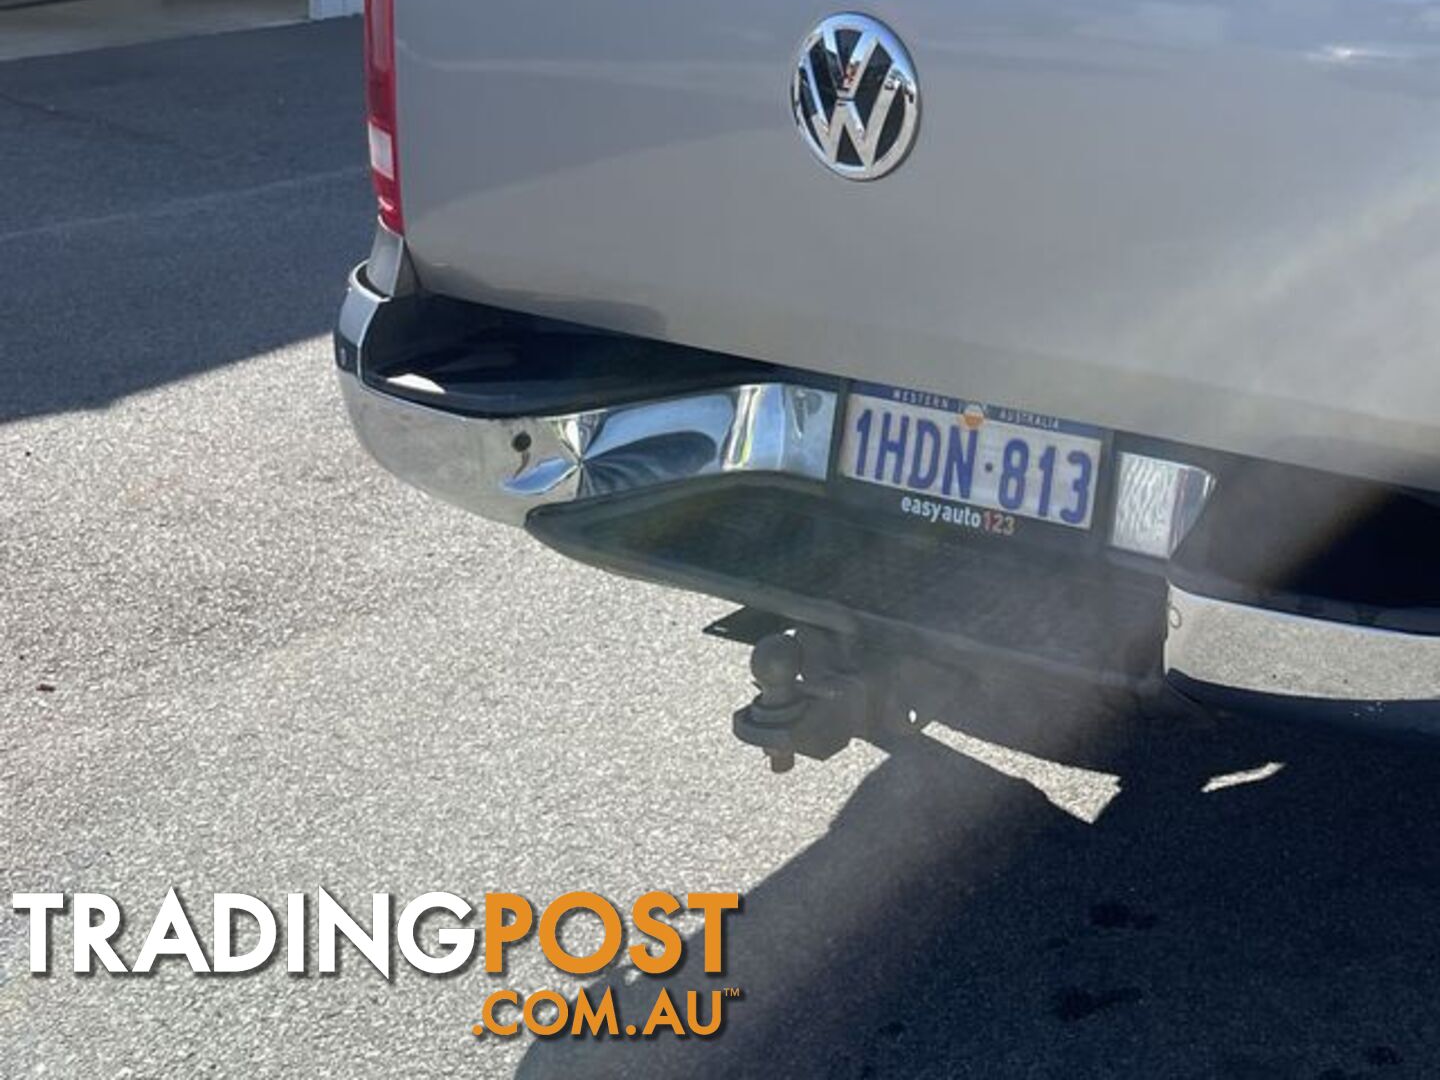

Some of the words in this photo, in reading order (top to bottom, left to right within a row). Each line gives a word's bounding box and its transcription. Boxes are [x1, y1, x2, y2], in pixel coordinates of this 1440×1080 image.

[892, 387, 949, 410] WESTERN
[999, 408, 1060, 430] AUSTRALIA
[901, 496, 1016, 536] easyauto123
